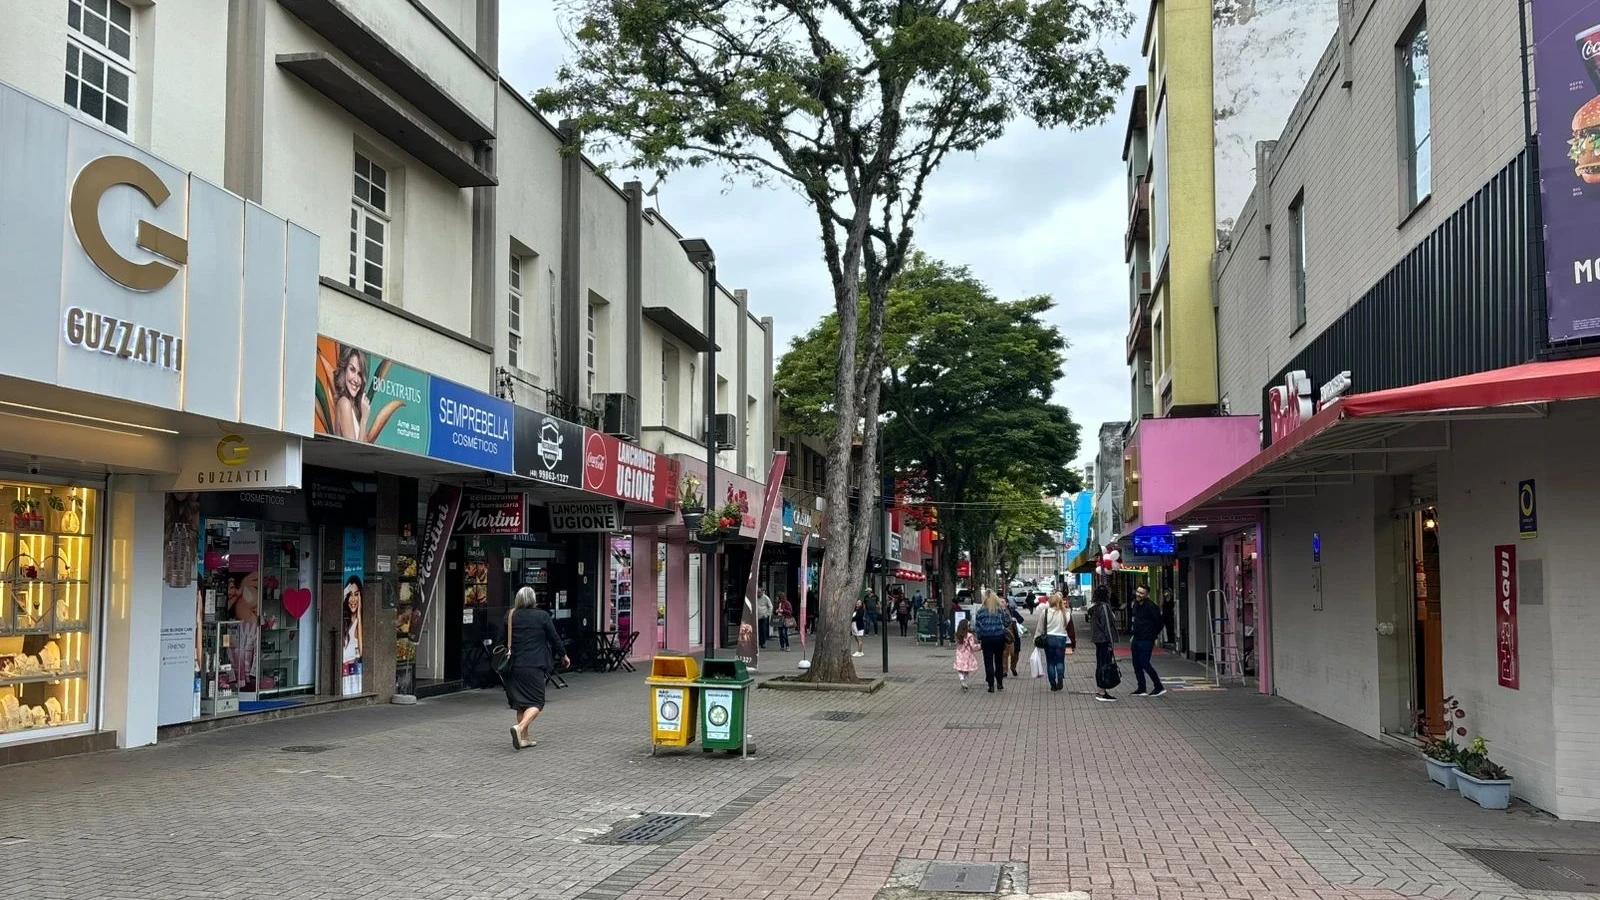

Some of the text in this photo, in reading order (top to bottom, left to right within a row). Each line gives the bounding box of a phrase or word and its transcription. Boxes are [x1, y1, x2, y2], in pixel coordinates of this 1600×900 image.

[71, 155, 188, 292] G
[66, 306, 183, 372] GUZZATTI
[373, 376, 421, 404] BIO EXTRATUS
[439, 397, 509, 441] SEMPREBELLA
[452, 431, 498, 455] COSMÉTICOS
[618, 441, 656, 472] LANCHONETE
[198, 469, 269, 484] GUZZATTI
[616, 463, 655, 503] UGIONE
[457, 509, 520, 531] Martini
[551, 503, 614, 514] LANCHONETE
[553, 515, 615, 529] UGIONE
[1502, 551, 1511, 615] AQUI
